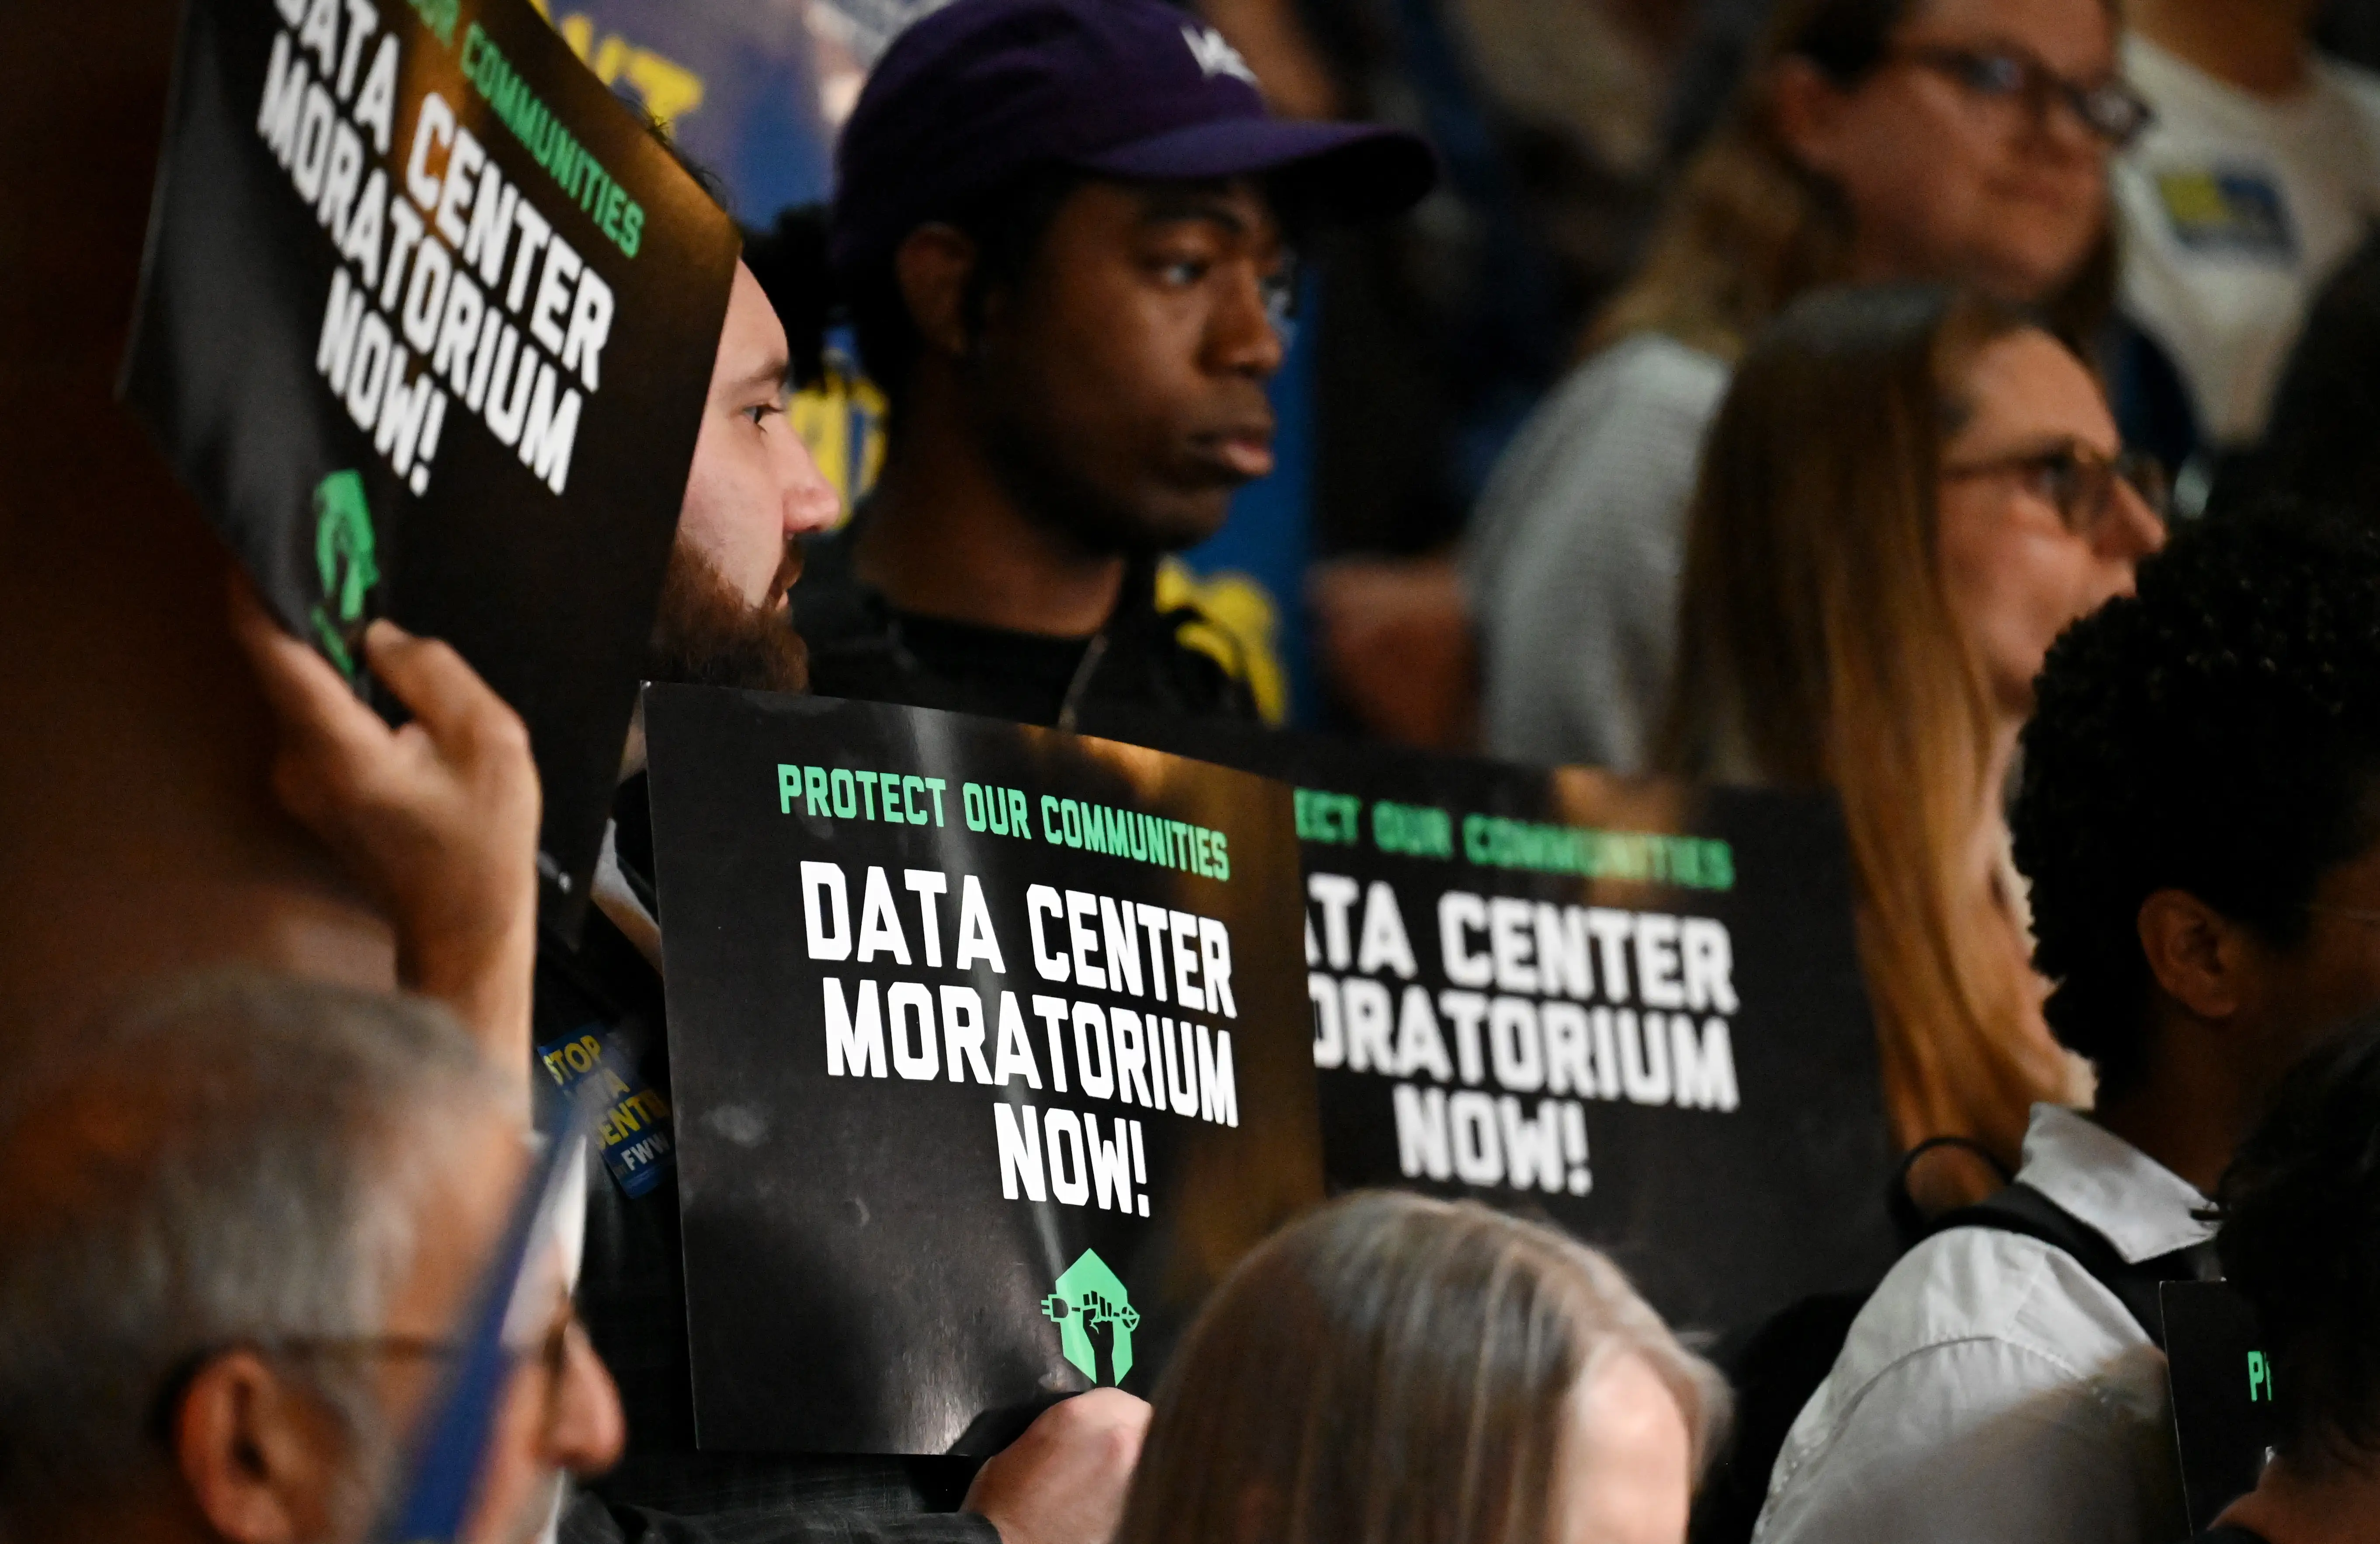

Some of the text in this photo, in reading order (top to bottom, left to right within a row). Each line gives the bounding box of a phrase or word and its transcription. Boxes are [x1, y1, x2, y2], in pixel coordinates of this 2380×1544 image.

[461, 21, 645, 258] COMMUNITIES
[259, 31, 582, 495] MORATORIUM
[406, 93, 614, 393] CENTER
[317, 267, 447, 496] NOW!
[778, 763, 1230, 881] PROTECT OUR COMMUNITIES
[800, 860, 1237, 1019] DATA CENTER
[1438, 890, 1739, 1014] CENTER
[823, 977, 1239, 1128] MORATORIUM
[993, 1102, 1150, 1218] NOW!
[1393, 1083, 1592, 1196] NOW!
